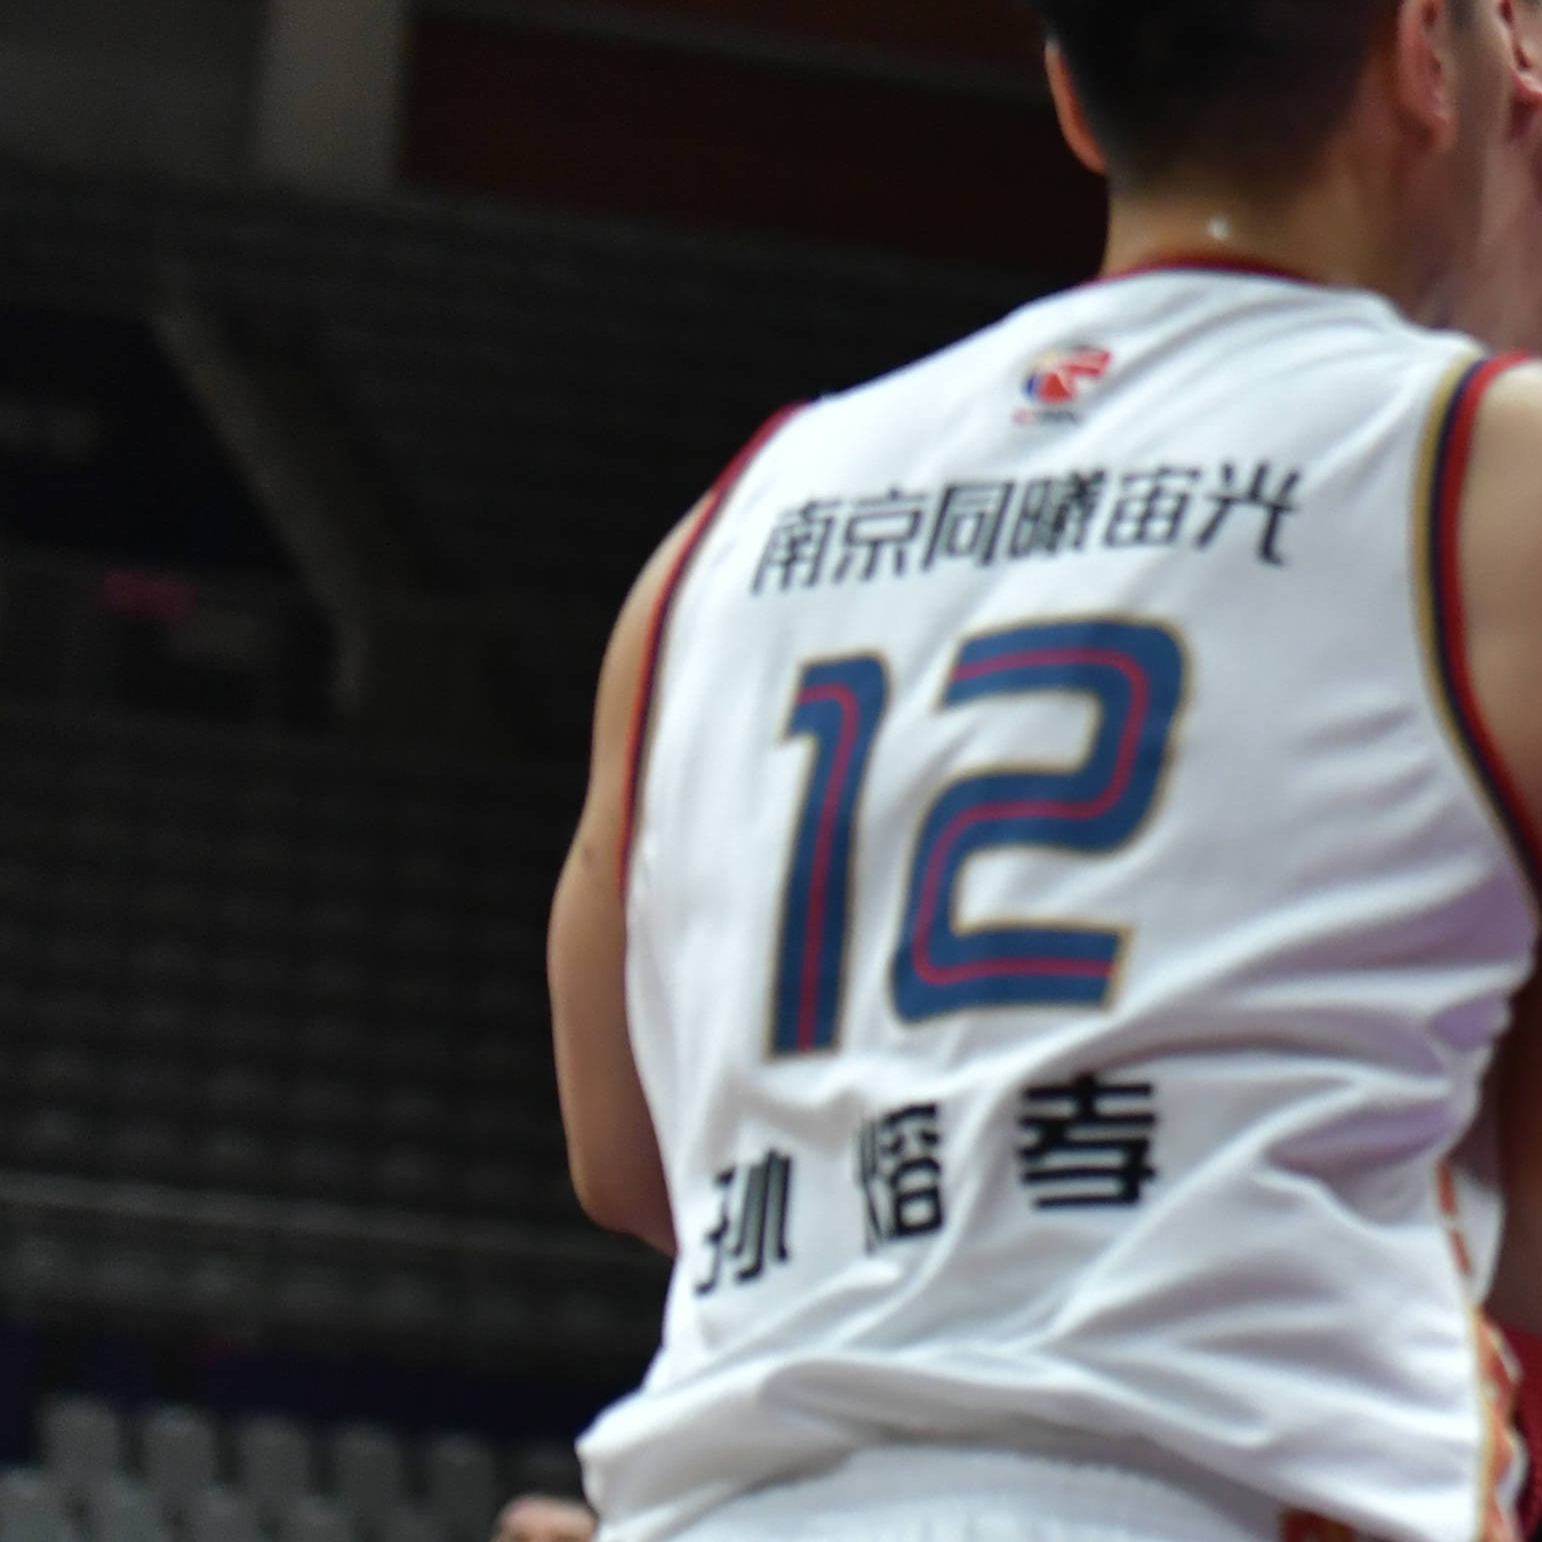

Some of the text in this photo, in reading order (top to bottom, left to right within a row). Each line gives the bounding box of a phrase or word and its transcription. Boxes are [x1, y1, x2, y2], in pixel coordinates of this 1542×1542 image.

[752, 462, 1299, 594] 南京同曦宙光
[767, 612, 1190, 1060] 12
